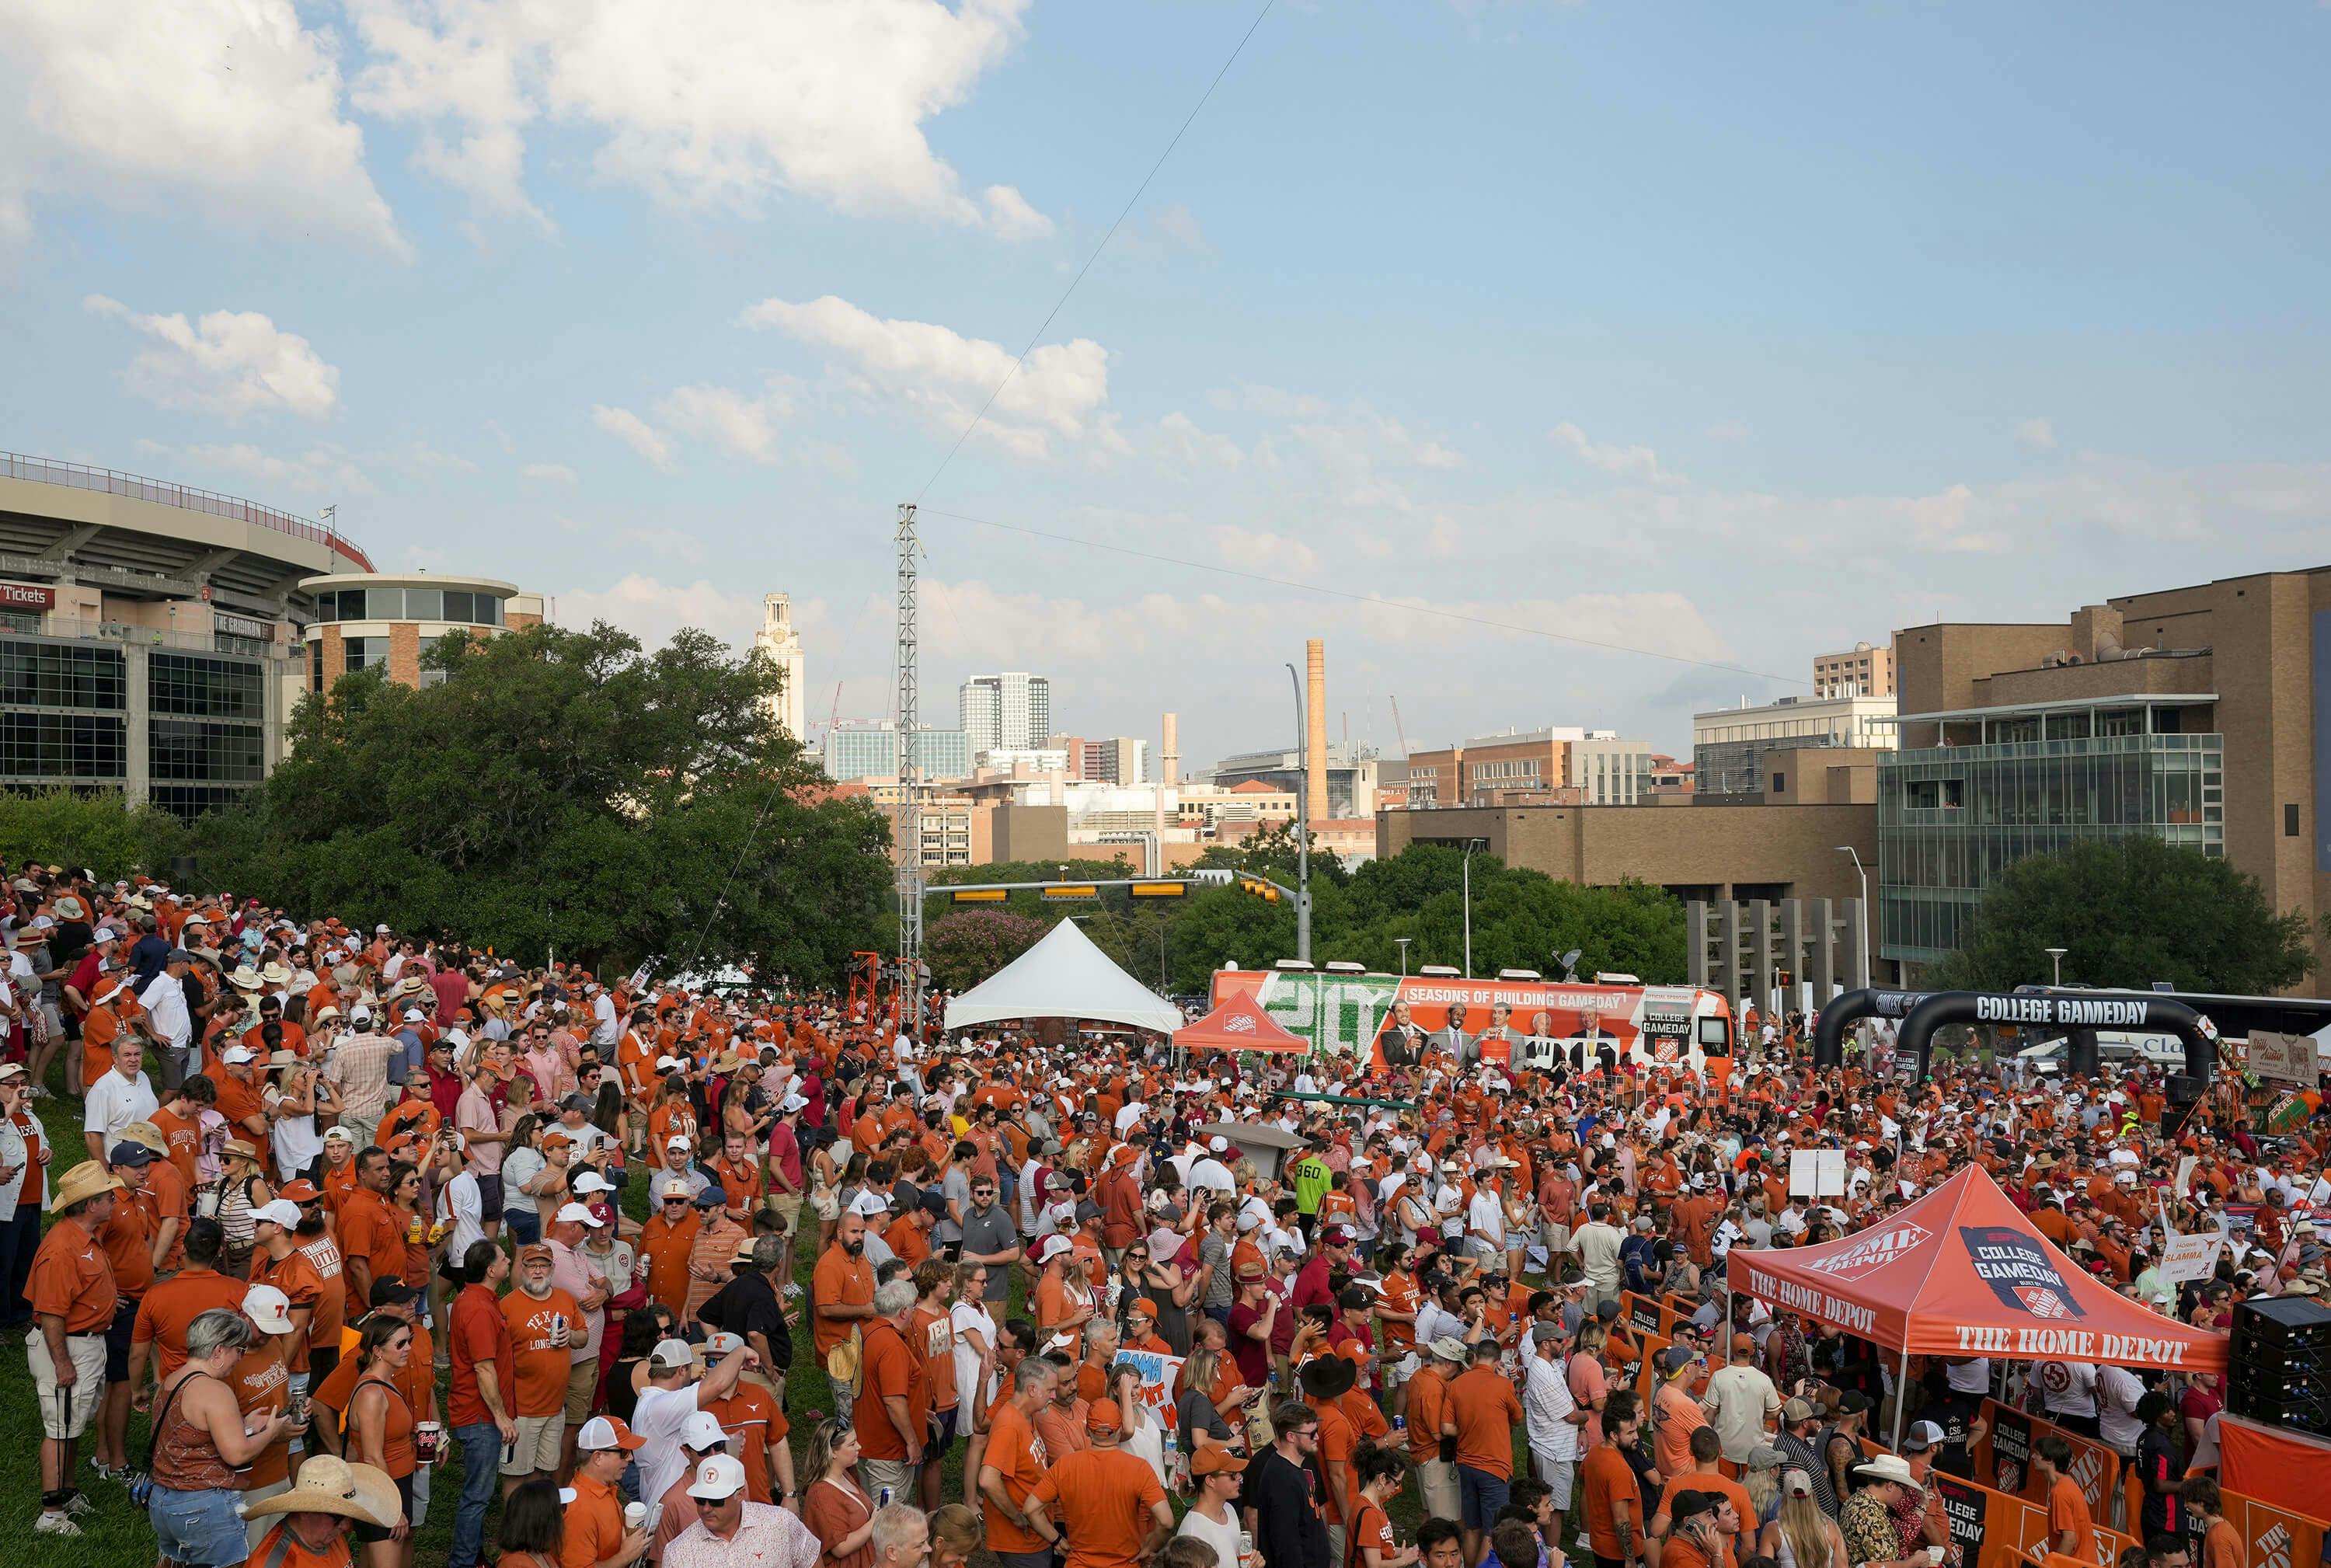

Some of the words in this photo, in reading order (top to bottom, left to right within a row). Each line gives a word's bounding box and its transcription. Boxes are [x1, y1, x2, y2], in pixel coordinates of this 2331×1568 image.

[5, 587, 45, 604] Tickets
[214, 615, 227, 631] THE
[228, 618, 261, 637] GRIDIRON
[1410, 988, 1469, 1002] SEASONS
[1474, 991, 1490, 1004] OF
[1494, 991, 1554, 1006] BUILDING
[1559, 995, 1620, 1009] GAMEDAY
[1650, 1012, 1685, 1023] COLLEGE
[1977, 996, 2052, 1023] COLLEGE
[2058, 1000, 2148, 1025] GAMEDAY
[1225, 1016, 1256, 1031] HOME
[1643, 1023, 1691, 1034] GAMEDAY
[1655, 1039, 1678, 1061] HOME
[2253, 1038, 2267, 1051] Still
[1297, 1164, 1321, 1179] 360
[671, 1183, 678, 1192] T
[312, 1246, 340, 1267] UTTA
[1810, 1227, 1922, 1269] HOME
[1977, 1246, 2045, 1266] COLLEGE
[2165, 1251, 2202, 1262] SLAMMA
[1826, 1250, 1900, 1273] DEPOT
[1974, 1262, 2063, 1287] GAMEDAY
[1402, 1288, 1420, 1301] TEXAS
[1749, 1268, 1777, 1298] THE
[1779, 1280, 1822, 1316] HOME
[1824, 1294, 1877, 1335] DEPOT
[2026, 1290, 2040, 1304] THE
[2031, 1289, 2058, 1318] HOME
[275, 1305, 284, 1319] T
[526, 1310, 570, 1331] TEXS
[1634, 1310, 1657, 1328] COLLEGE
[714, 1336, 726, 1348] T
[1956, 1326, 2012, 1352] THE
[2019, 1328, 2096, 1357] HOME
[2101, 1333, 2190, 1364] DEPOT
[1949, 1426, 1961, 1436] CSG
[1998, 1423, 2026, 1444] COLLEGE
[1992, 1434, 2030, 1462] GAMEDAY
[708, 1471, 715, 1479] T
[1943, 1497, 1977, 1521] LLEGE
[1949, 1520, 1984, 1543] EDAY
[2255, 1521, 2291, 1556] THE
